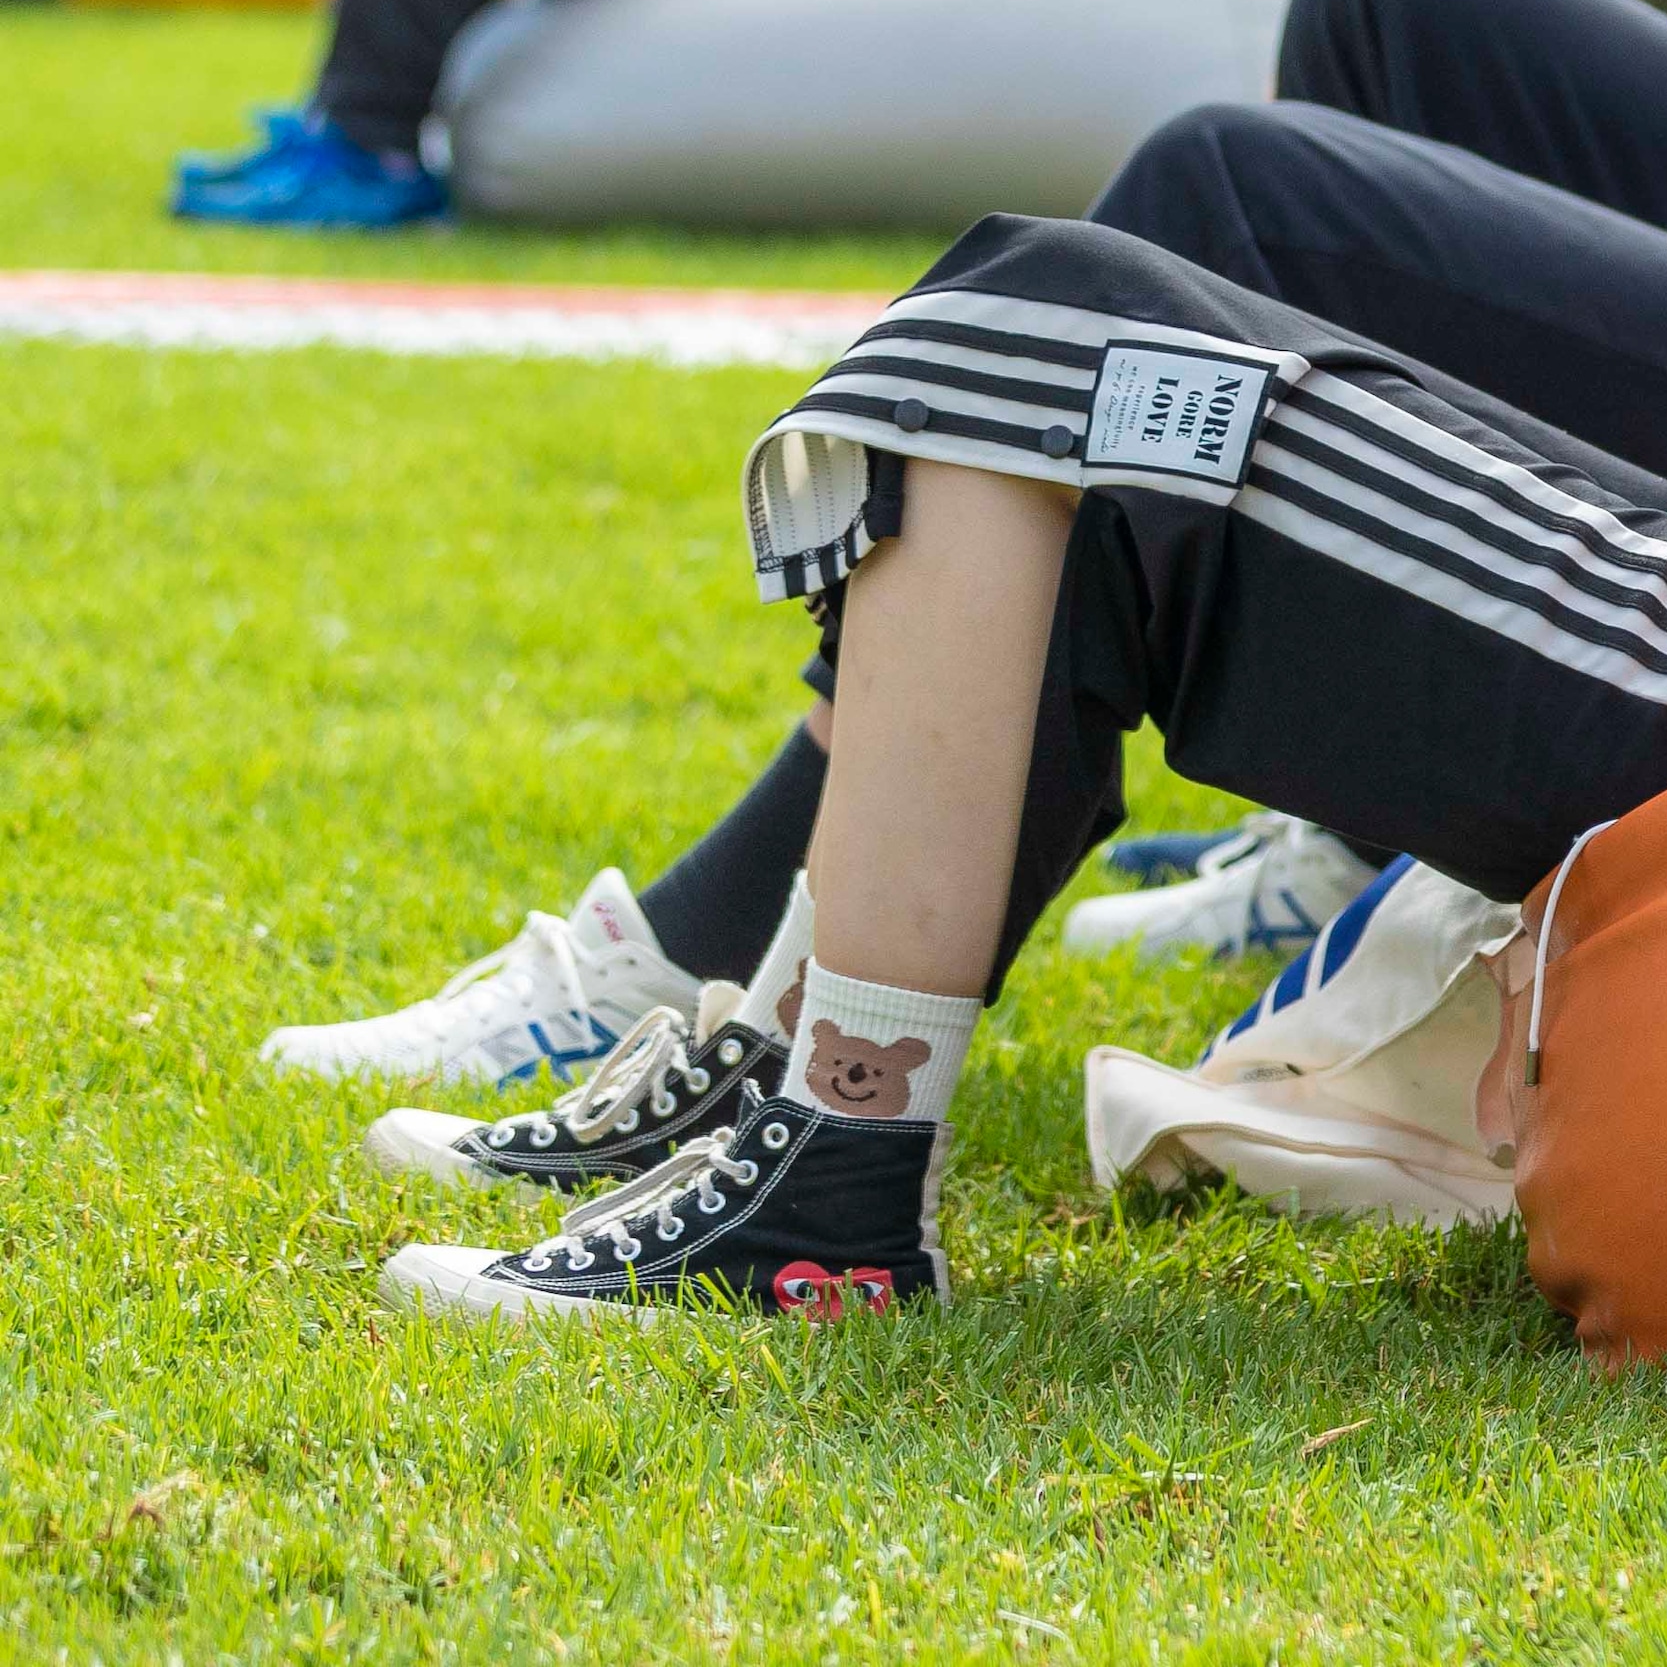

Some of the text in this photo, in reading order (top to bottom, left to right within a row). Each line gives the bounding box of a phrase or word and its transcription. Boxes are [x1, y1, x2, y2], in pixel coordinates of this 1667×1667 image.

[1141, 377, 1180, 443] LOVE
[1176, 390, 1204, 438] GORE
[1193, 374, 1244, 465] NORM
